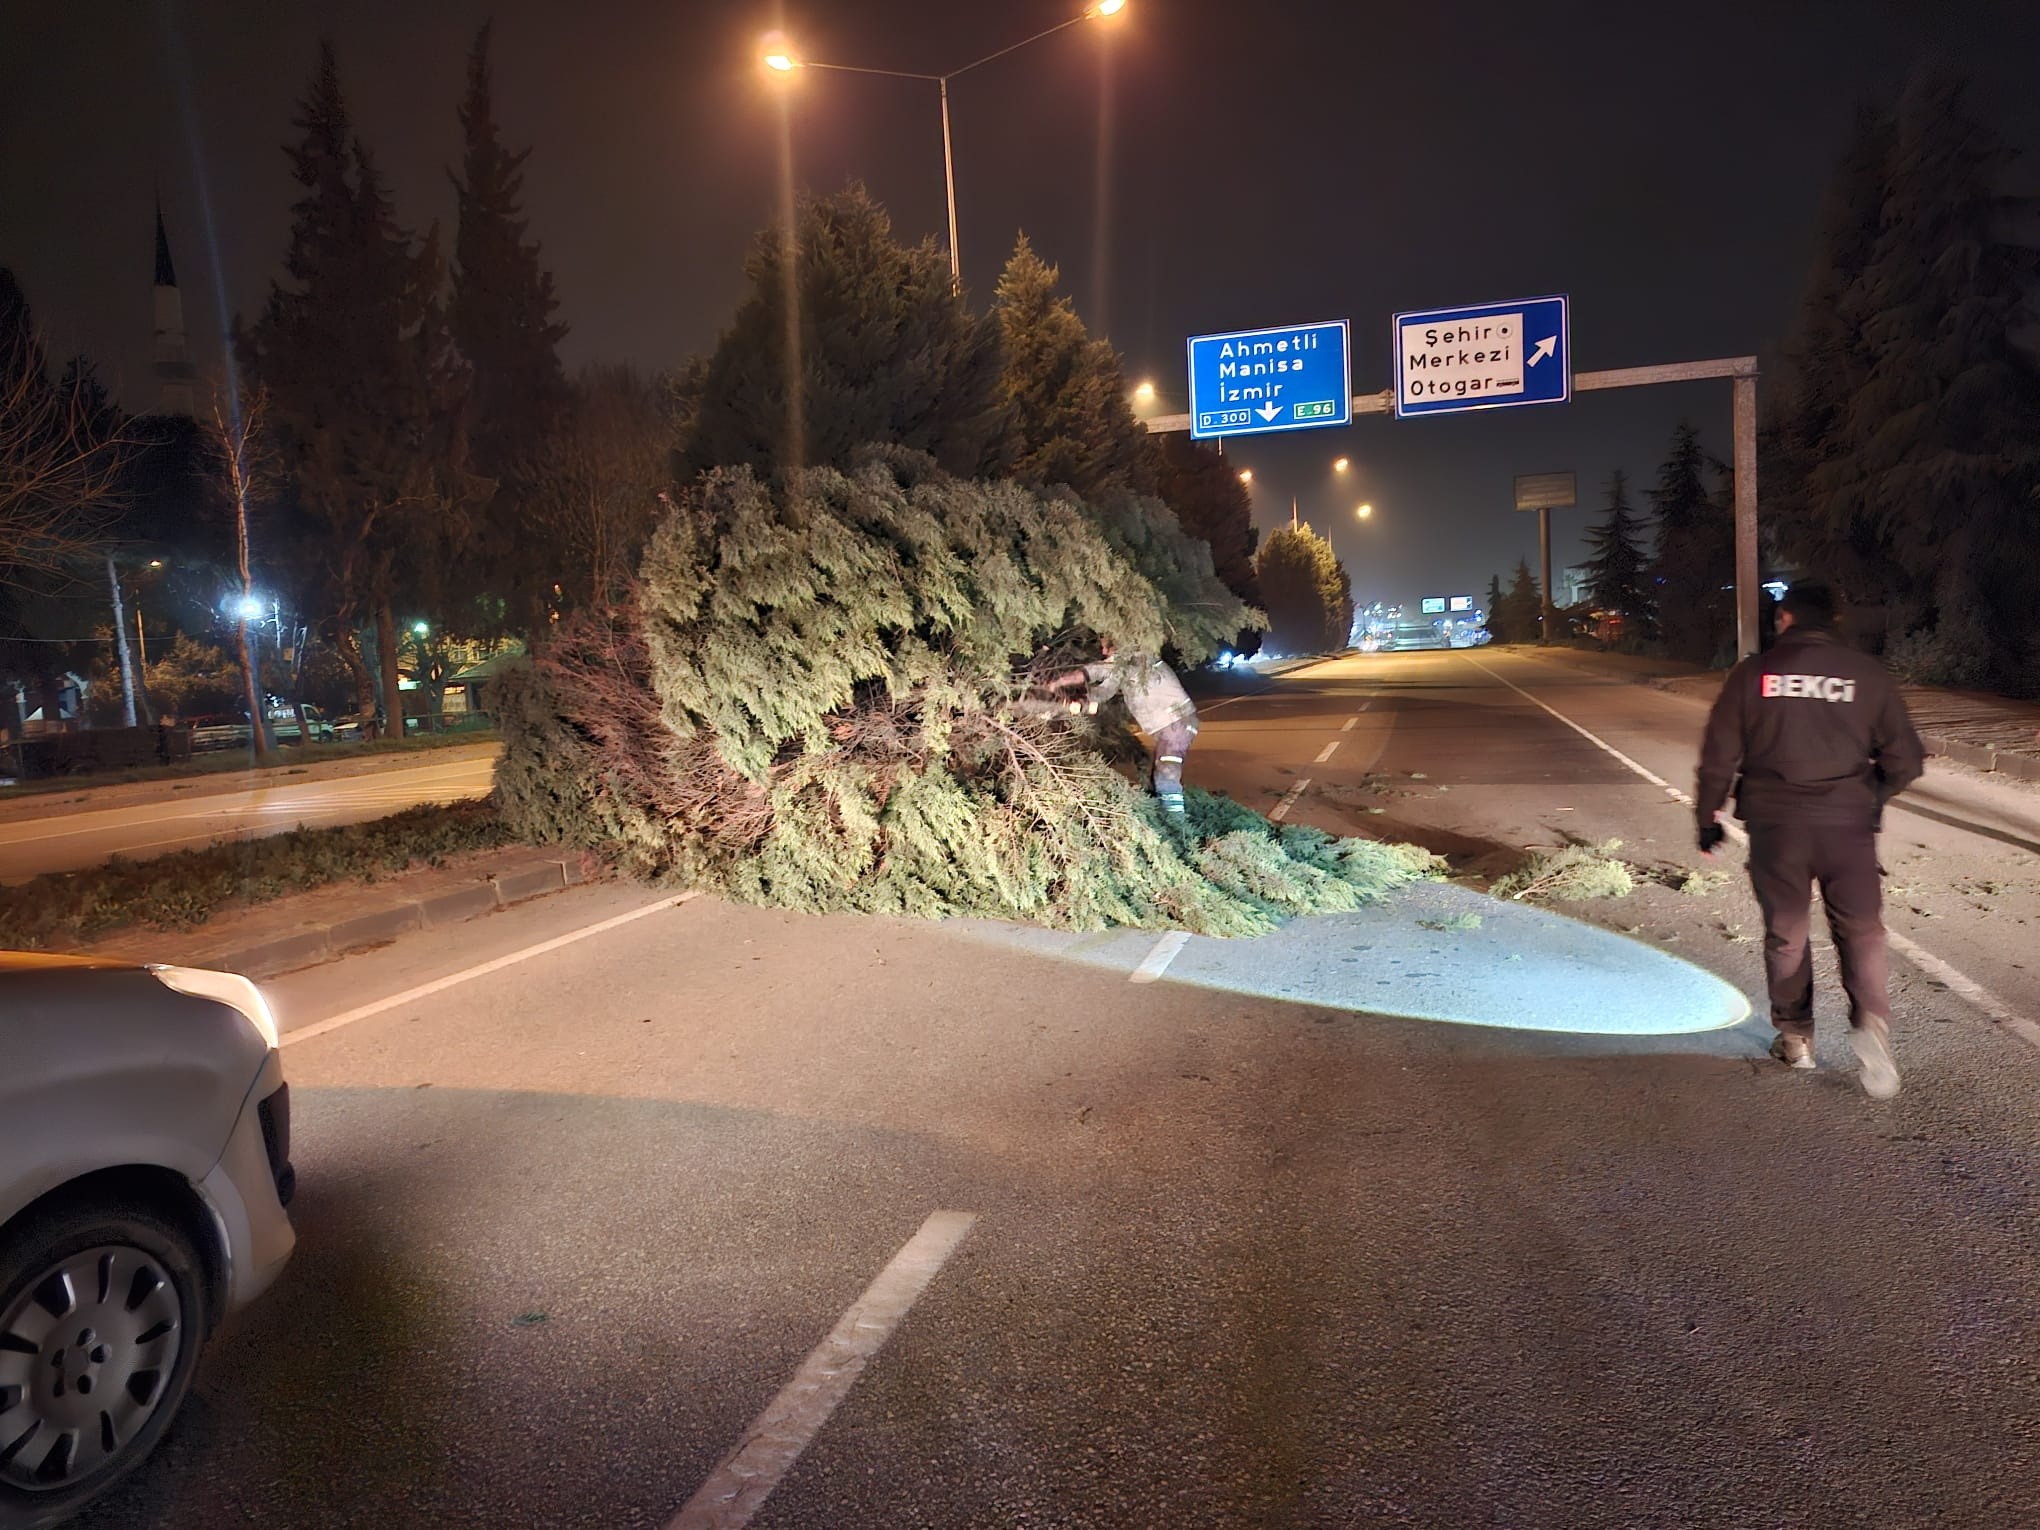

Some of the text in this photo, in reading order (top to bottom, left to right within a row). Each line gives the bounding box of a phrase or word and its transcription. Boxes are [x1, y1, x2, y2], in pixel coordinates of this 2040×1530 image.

[1219, 333, 1318, 359] Ahmetli
[1425, 326, 1492, 347] Şehir
[1219, 358, 1304, 379] Manisa
[1410, 346, 1509, 370] Merkezi
[1220, 382, 1284, 403] İzmir
[1411, 377, 1493, 396] Otogar
